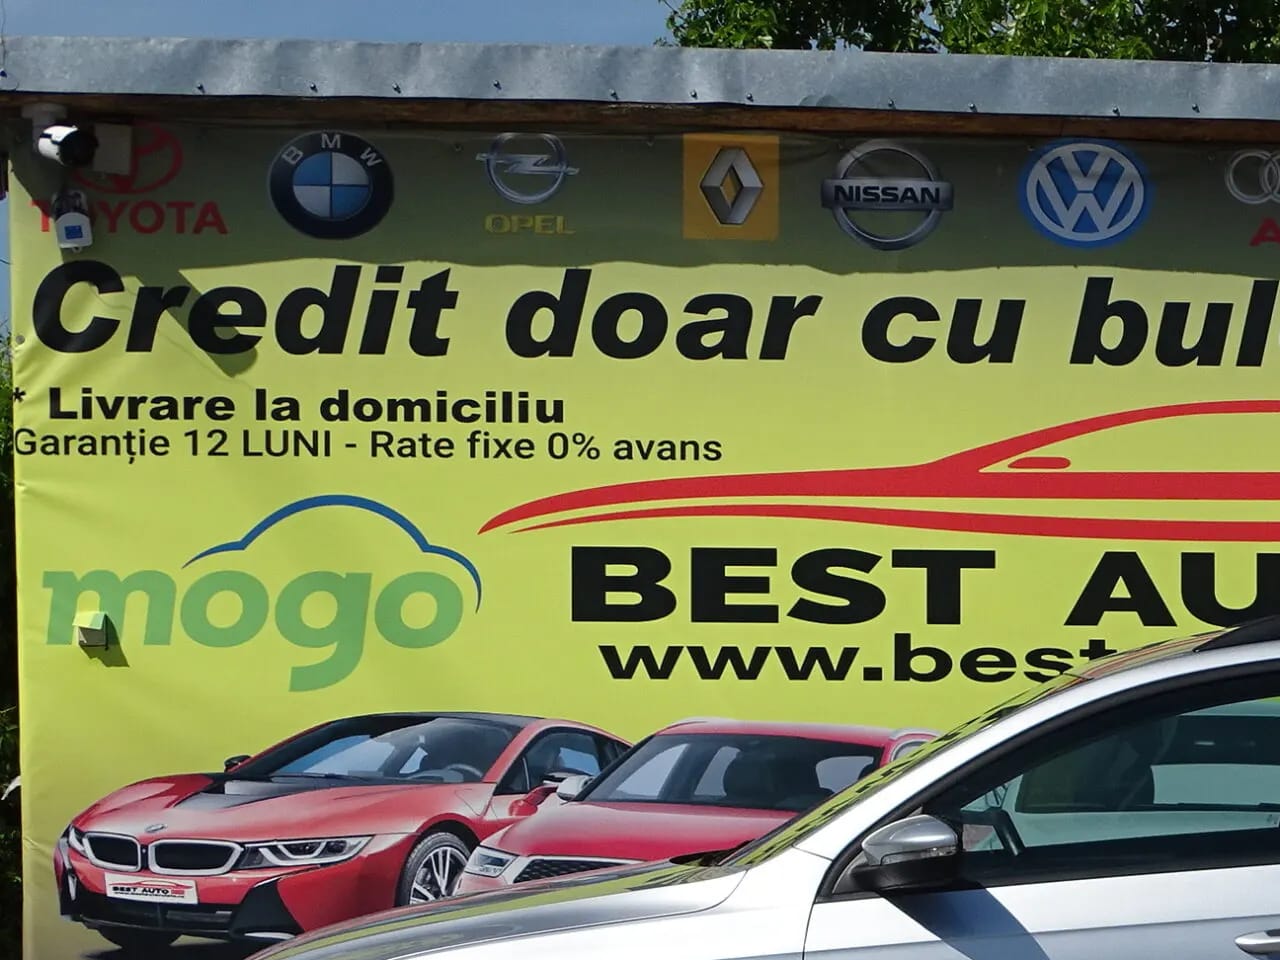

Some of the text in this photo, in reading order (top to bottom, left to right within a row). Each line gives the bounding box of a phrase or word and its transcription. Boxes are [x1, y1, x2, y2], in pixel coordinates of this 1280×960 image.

[280, 132, 383, 168] BMW
[833, 184, 941, 204] NISSAN
[30, 199, 229, 235] TYOTA
[484, 213, 577, 235] OPEL
[32, 260, 459, 357] Credit
[505, 268, 823, 361] doar
[861, 296, 1026, 365] cu
[49, 387, 564, 424] Livrare la domiciliu
[13, 428, 170, 465] Garanție
[184, 428, 229, 457] 12
[243, 429, 331, 457] LUNI
[371, 430, 455, 458] Rate
[467, 430, 535, 459] fixe
[548, 432, 601, 460] 0%
[613, 439, 722, 461] avans
[571, 546, 996, 625] BEST
[42, 570, 464, 692] mogo
[141, 887, 169, 895] AUTO
